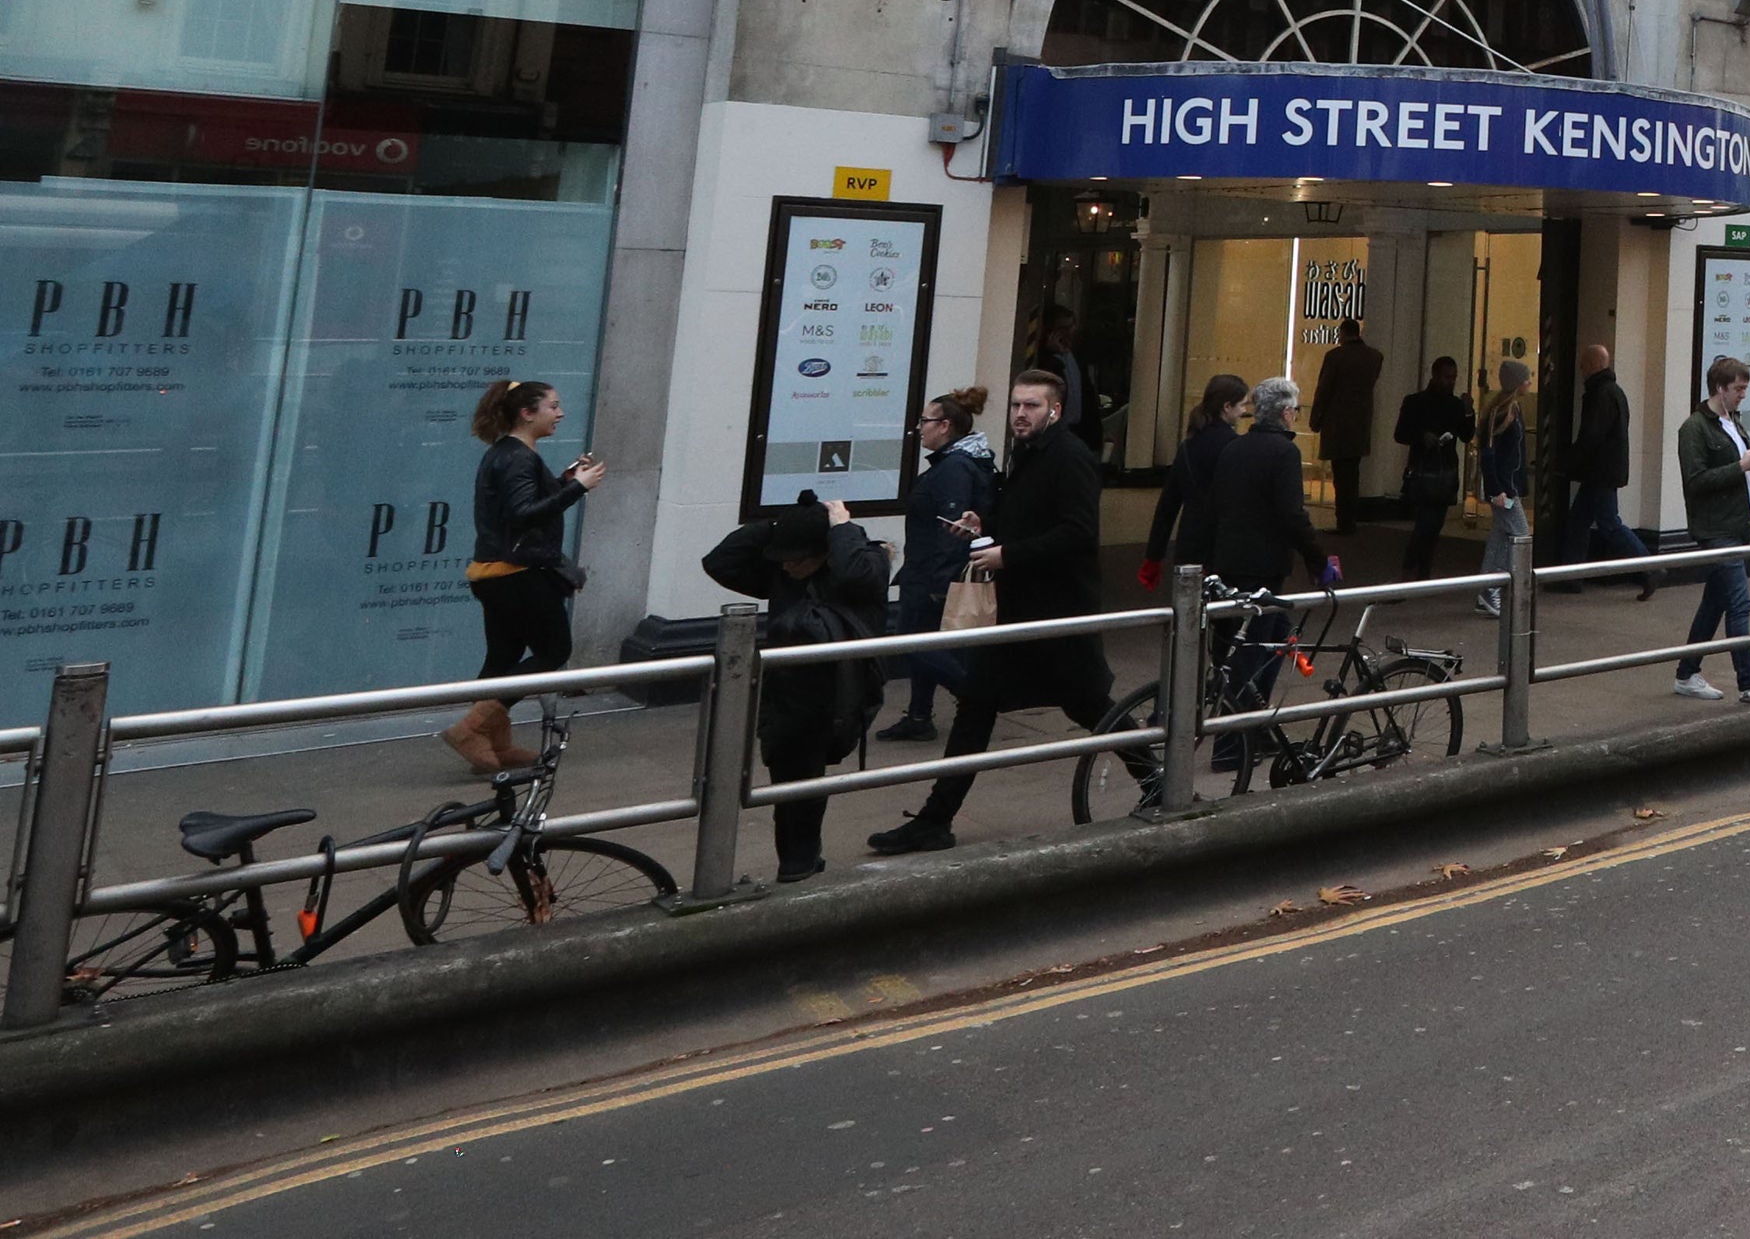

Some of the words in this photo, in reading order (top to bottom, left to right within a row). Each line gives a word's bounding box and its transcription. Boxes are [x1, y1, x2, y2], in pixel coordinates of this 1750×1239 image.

[1122, 98, 1258, 145] HIGH
[1281, 99, 1502, 151] STREET
[847, 177, 877, 189] RVP
[1732, 231, 1747, 240] SAP
[804, 303, 838, 311] NERO
[865, 303, 893, 312] LEON
[802, 325, 834, 337] M&S
[24, 343, 192, 355] SHOPFITTERS
[392, 345, 527, 356] SHOPFITTERS
[107, 367, 132, 376] 707
[368, 501, 449, 558] PB
[1, 577, 156, 596] HOPFITTERS
[70, 604, 95, 616] 707
